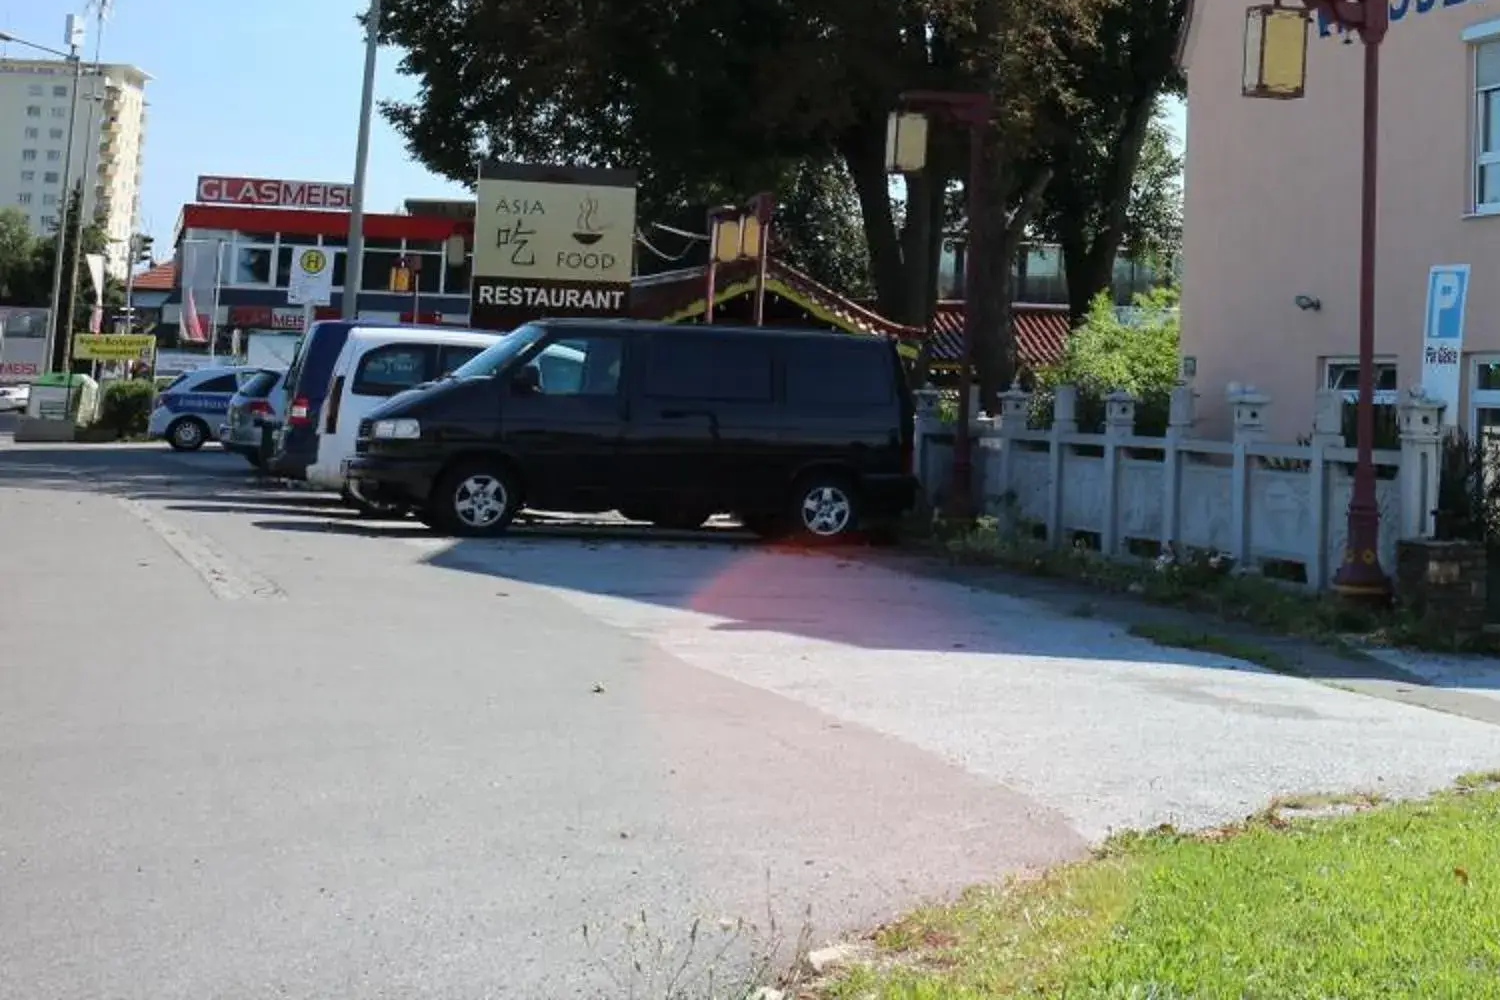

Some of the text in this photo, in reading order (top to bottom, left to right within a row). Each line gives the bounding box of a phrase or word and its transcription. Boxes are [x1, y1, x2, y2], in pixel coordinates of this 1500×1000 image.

[496, 199, 545, 215] ASIA
[496, 219, 537, 266] 吃
[556, 251, 616, 270] FOOD
[479, 285, 625, 310] RESTAURANT
[1431, 272, 1459, 337] P
